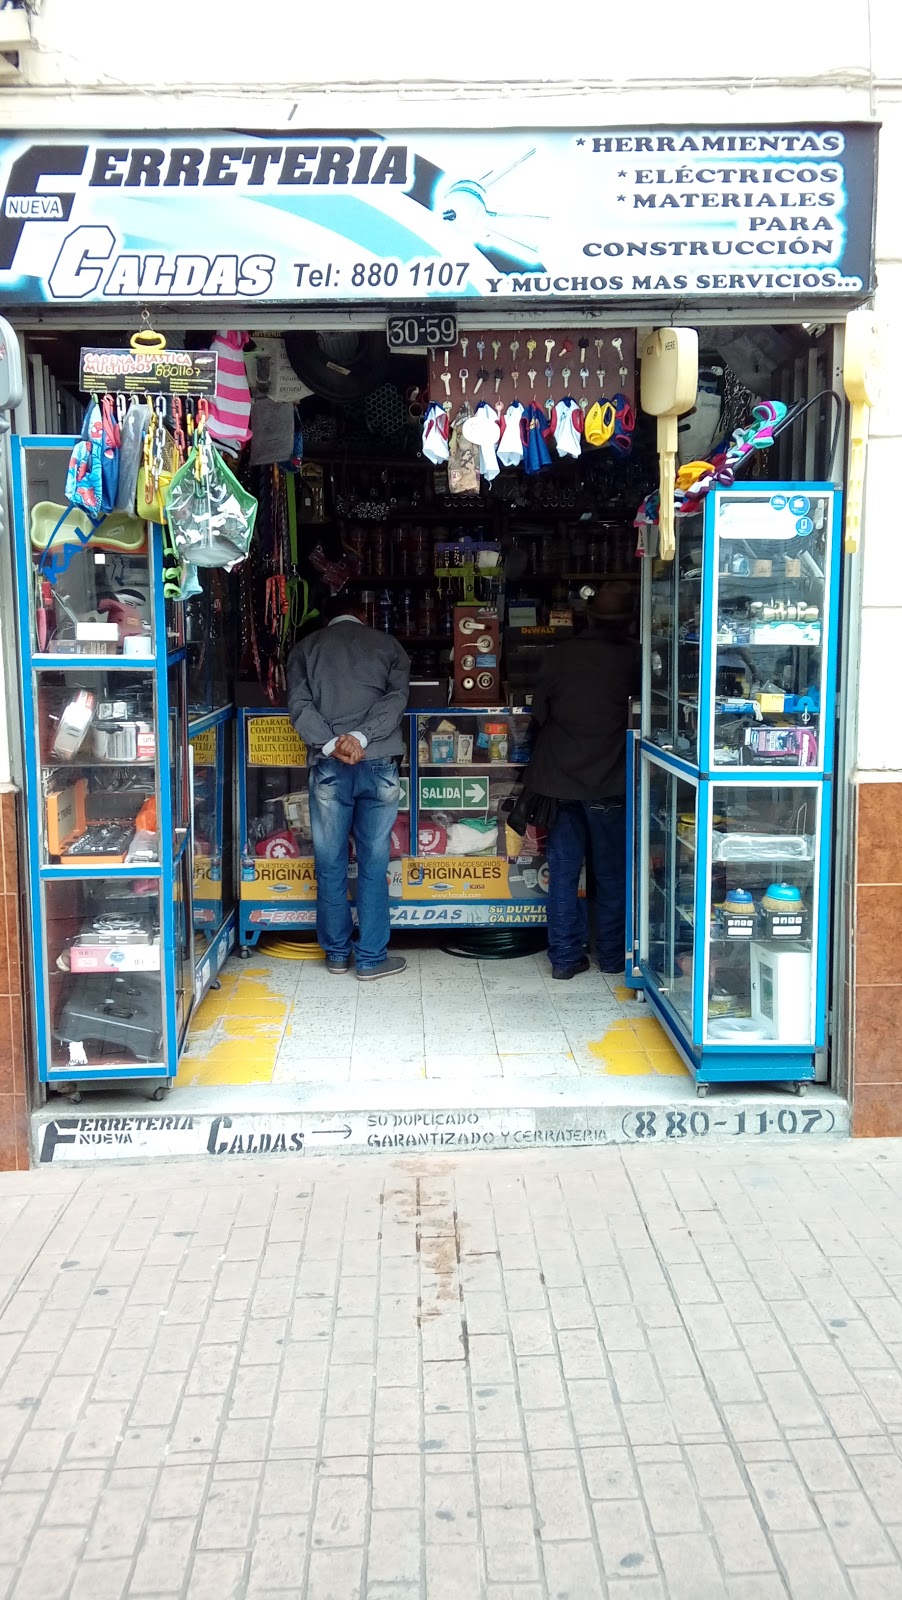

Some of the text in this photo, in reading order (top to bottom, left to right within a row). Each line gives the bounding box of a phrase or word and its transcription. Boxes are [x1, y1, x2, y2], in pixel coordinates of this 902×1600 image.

[591, 136, 840, 153] HERRAMIENTAS
[634, 165, 839, 184] ELÉCTRICOS
[0, 144, 409, 270] FERRETERIA
[7, 199, 61, 217] NUEVA
[632, 192, 836, 208] MATERIALES
[748, 216, 834, 231] PARA
[582, 236, 834, 257] CONSTRUCCIÓN
[48, 225, 276, 299] CALDAS
[293, 262, 470, 287] Tel: 880 1107
[485, 278, 503, 293] Y
[512, 276, 624, 292] MUCHOS
[632, 275, 688, 290] MAS
[390, 317, 455, 344] 30-59
[422, 787, 461, 799] SALIDA
[410, 867, 502, 880] ORIGINALES
[39, 1115, 305, 1163] FERRETERIA CALDAS
[79, 1133, 133, 1145] NUEVA
[367, 1132, 495, 1147] GARANTIZADO
